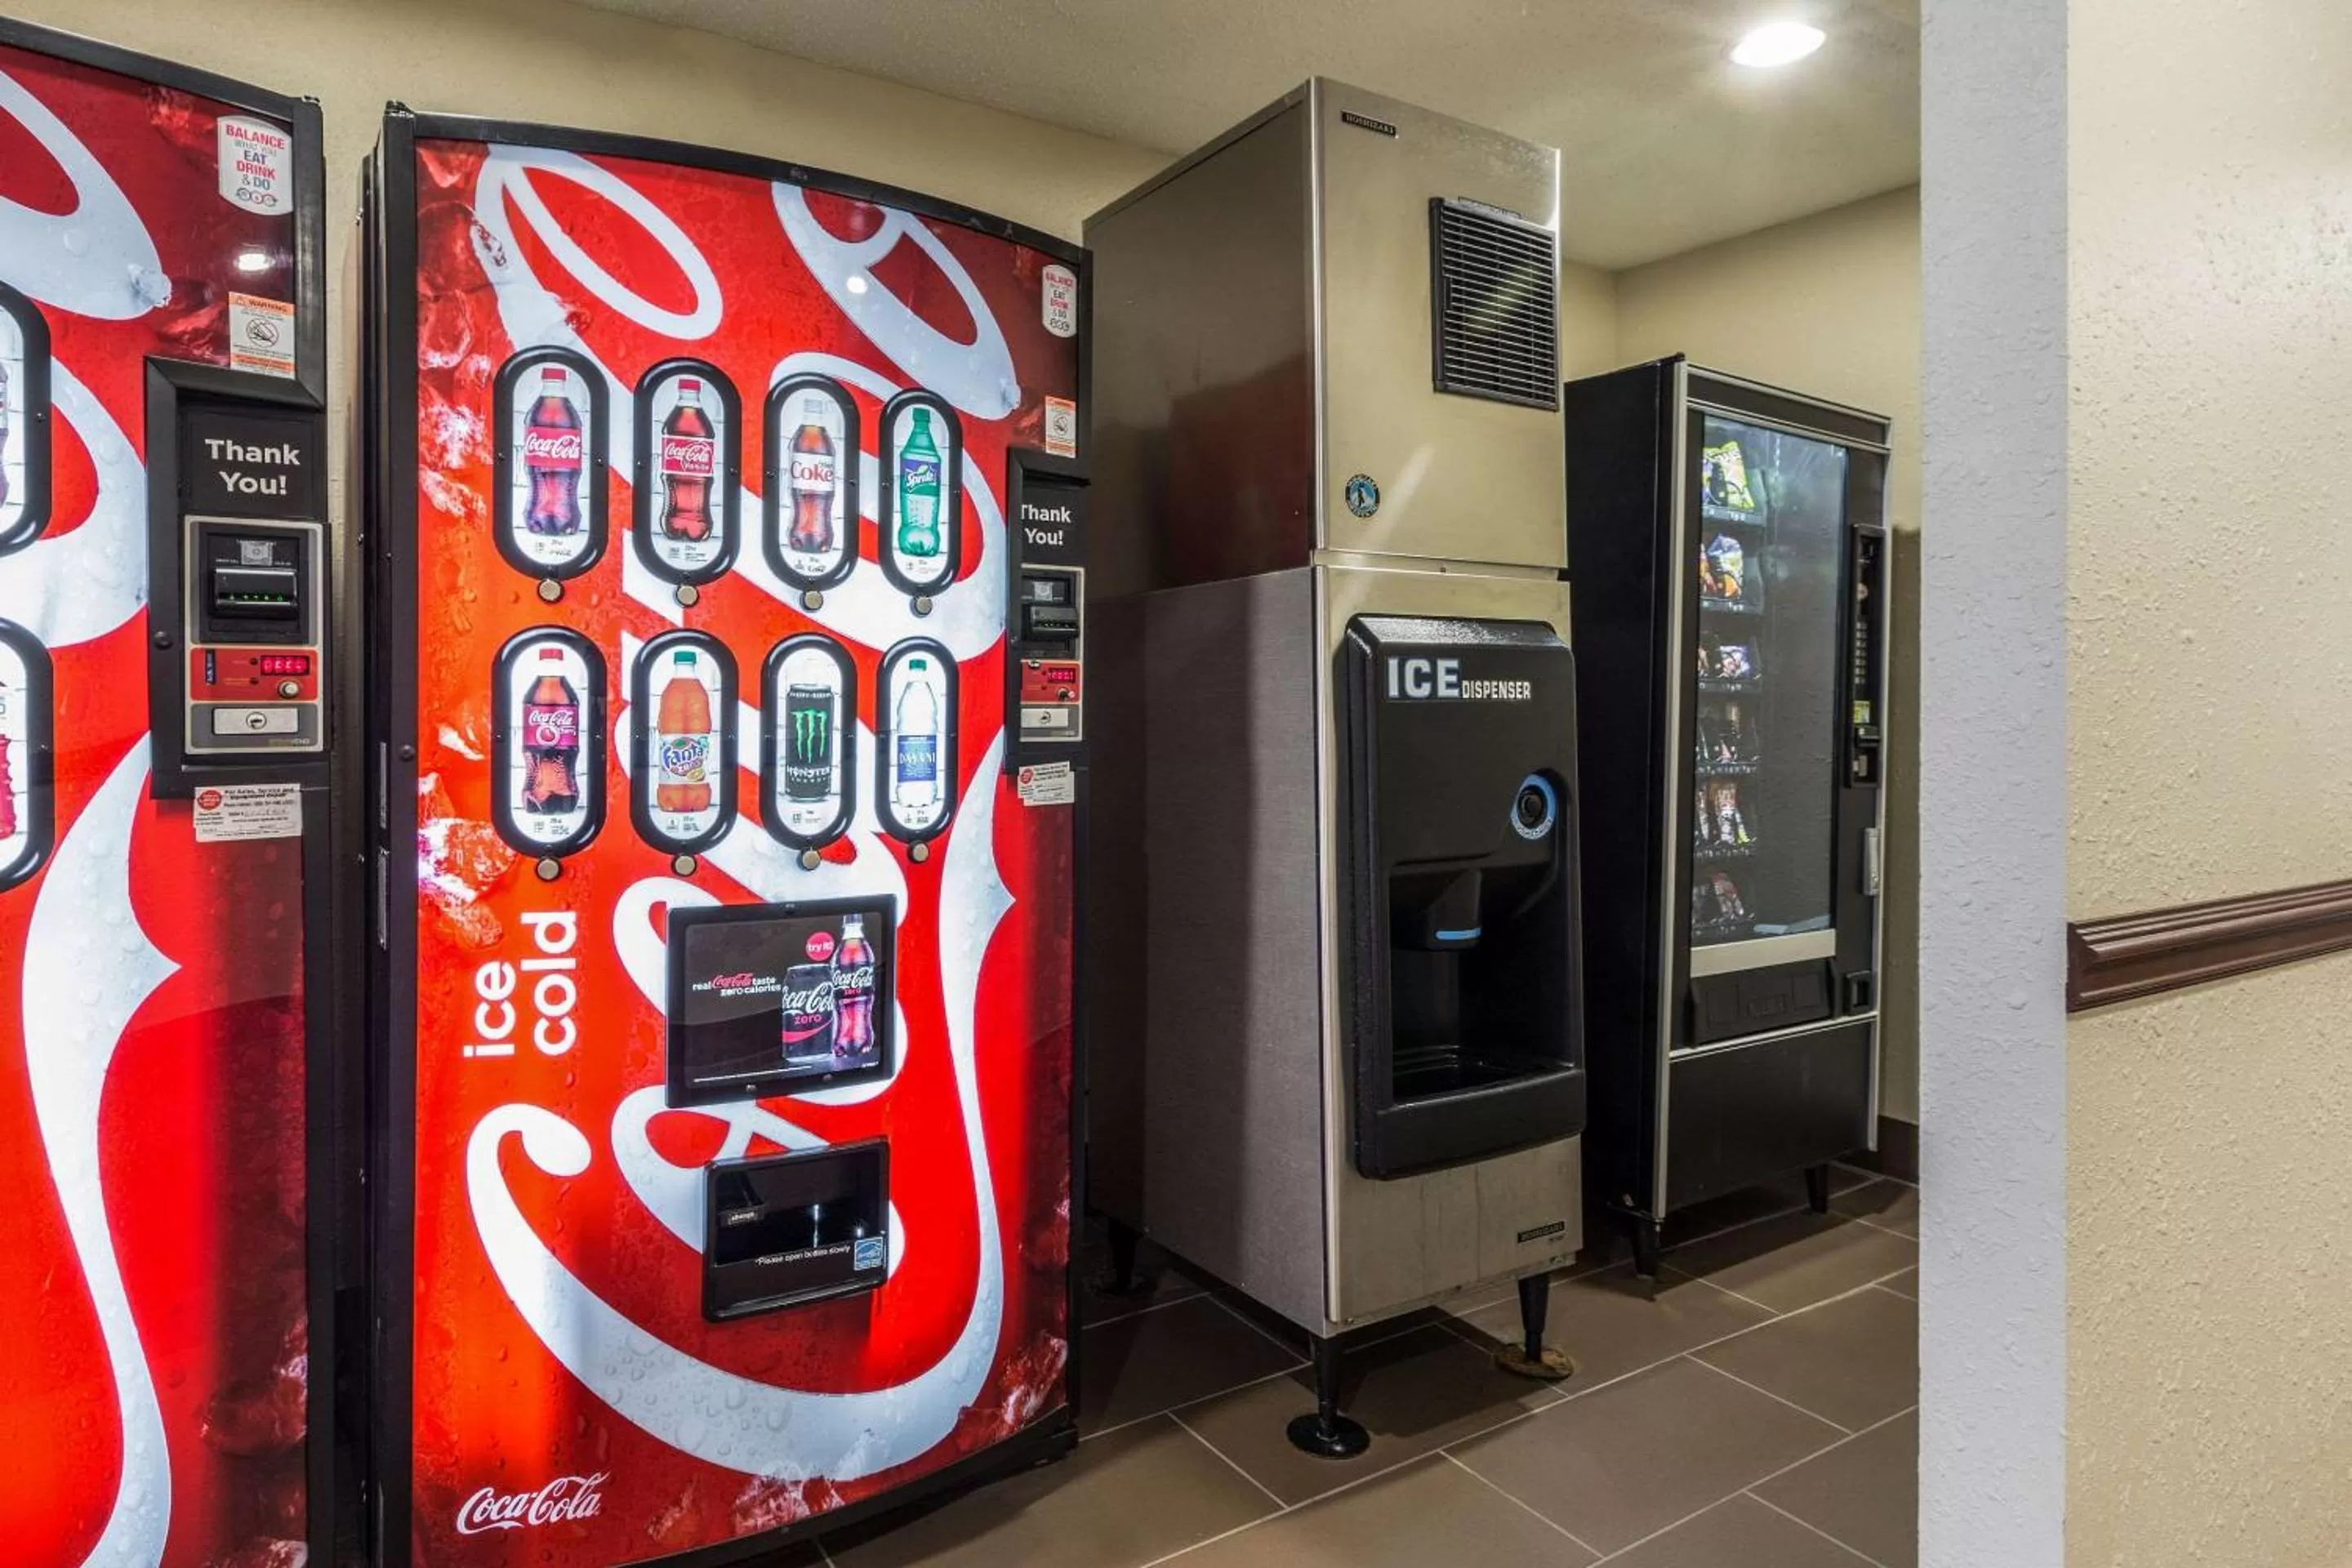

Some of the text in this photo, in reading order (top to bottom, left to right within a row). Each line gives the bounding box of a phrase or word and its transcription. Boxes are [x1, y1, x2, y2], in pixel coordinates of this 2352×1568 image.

[225, 124, 285, 149] BALANCE
[244, 150, 267, 165] EAT
[236, 160, 276, 180] DRINK
[253, 176, 270, 190] DO
[205, 439, 301, 466] Thank
[525, 432, 581, 459] Coca-Cola
[665, 442, 712, 462] Coca-Cola
[791, 460, 834, 482] Coke
[219, 471, 287, 495] You!
[1021, 504, 1071, 523] Thank
[1024, 528, 1063, 546] You!
[1388, 657, 1531, 699] ICE DISPENSER
[520, 911, 577, 1055] cold
[692, 981, 711, 991] real
[752, 977, 776, 985] taste
[719, 984, 782, 996] zero calories
[464, 961, 516, 1057] ice
[794, 1014, 822, 1025] zero
[457, 1469, 611, 1535] Coca-Cola
